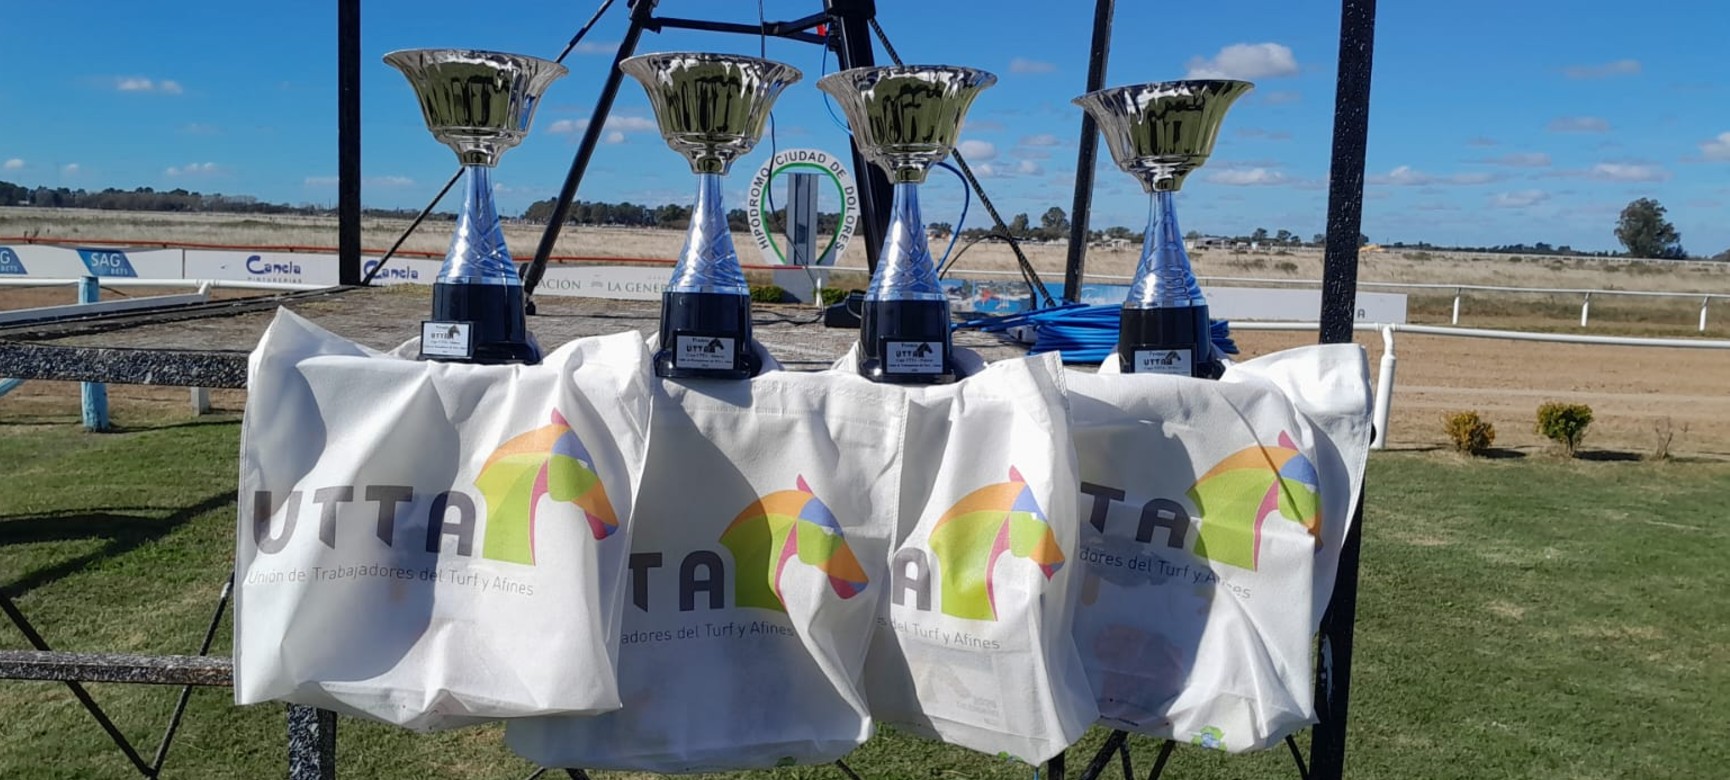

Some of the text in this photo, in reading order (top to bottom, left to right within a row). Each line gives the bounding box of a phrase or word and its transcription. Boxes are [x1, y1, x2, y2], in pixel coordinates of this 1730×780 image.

[775, 150, 827, 165] CIUDAD
[830, 161, 847, 179] DE
[834, 186, 857, 251] DOLORES
[0, 250, 10, 264] G
[90, 252, 121, 268] SAG
[537, 276, 581, 289] ACIÓN
[608, 281, 669, 294] LA GENER
[1357, 308, 1366, 319] A
[253, 485, 477, 557] UTTA
[1080, 481, 1191, 549] TA
[1079, 547, 1123, 567] dores
[1128, 555, 1152, 572] del
[1158, 560, 1190, 578] Turf
[1193, 571, 1202, 585] y
[248, 563, 535, 597] Unión de Trabajadores del Turf y Afines
[628, 549, 725, 613] TA
[891, 547, 932, 612] A
[621, 621, 794, 645] adores del Turf y Afines
[911, 622, 939, 640] Turf
[942, 632, 951, 645] y
[953, 631, 1001, 650] Afines
